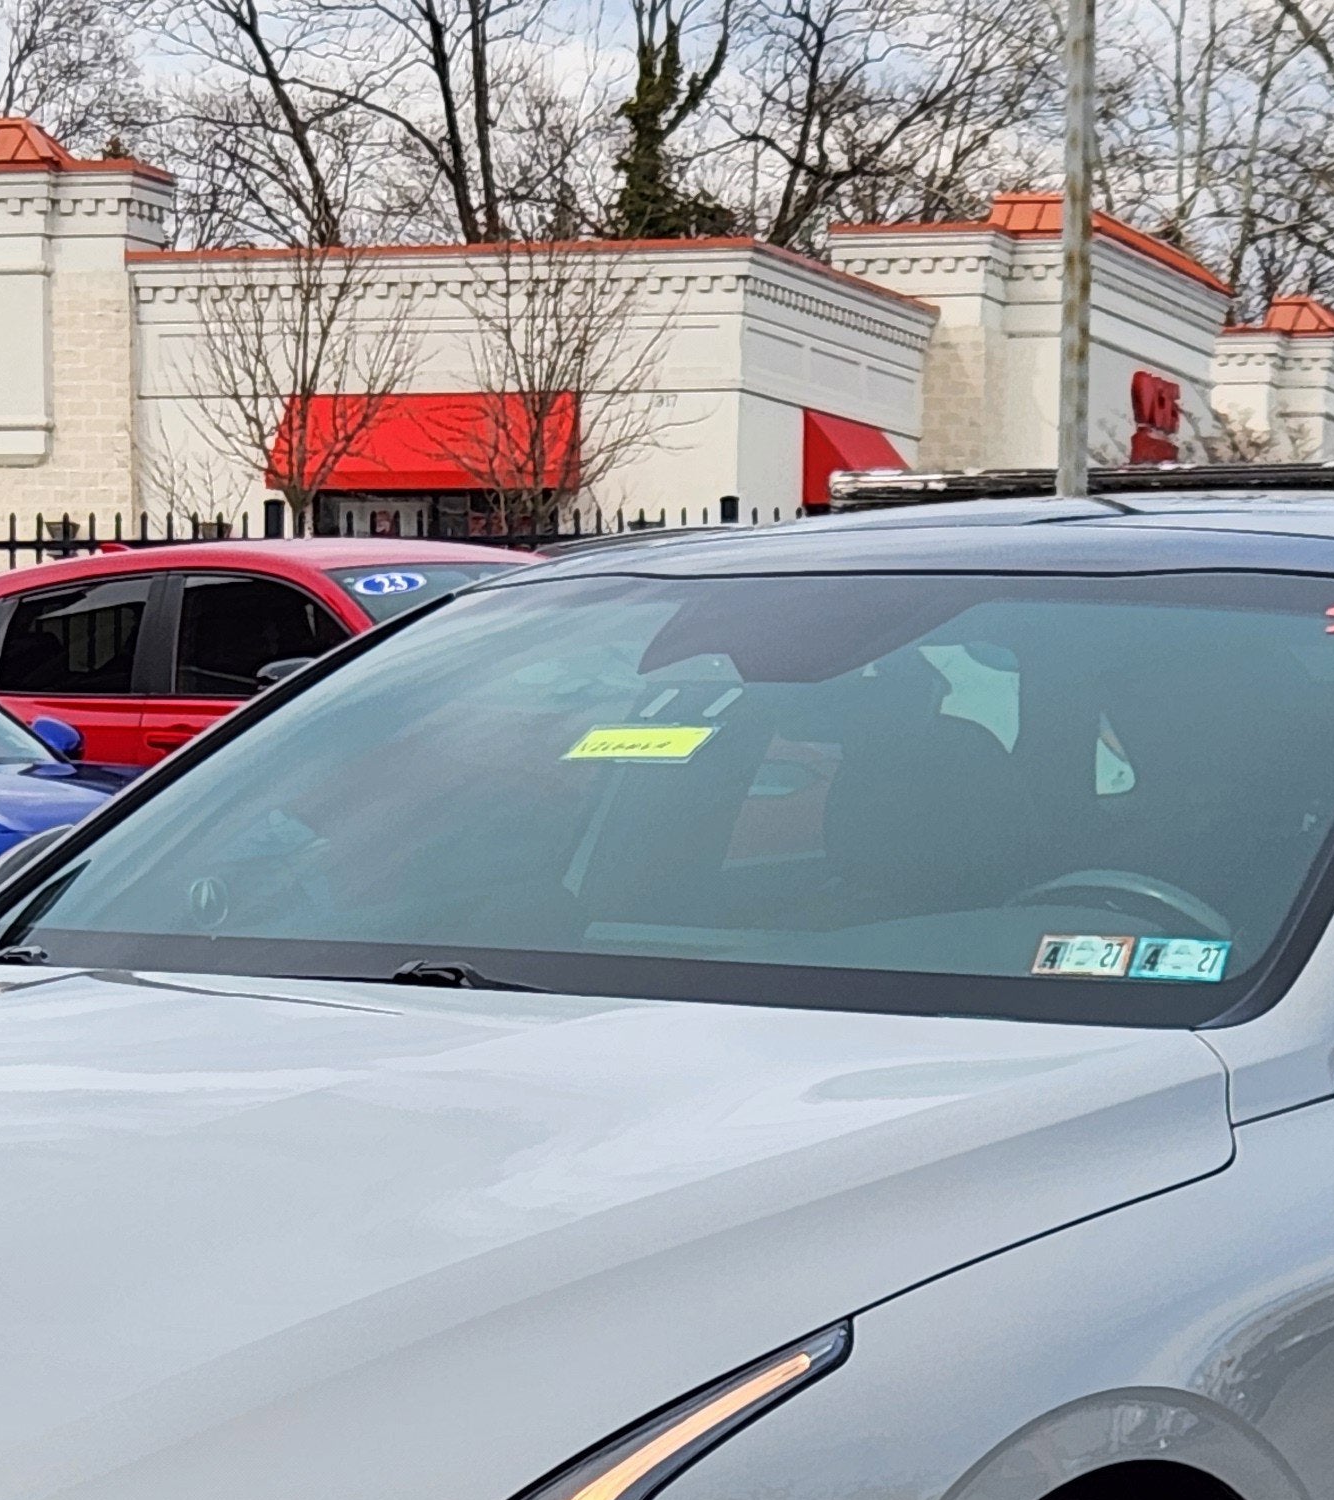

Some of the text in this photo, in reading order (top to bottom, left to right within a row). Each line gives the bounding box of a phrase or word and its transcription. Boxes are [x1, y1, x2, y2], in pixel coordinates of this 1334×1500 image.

[374, 574, 408, 593] 23
[1040, 943, 1124, 969] 4 27
[1142, 947, 1222, 973] 4 27
